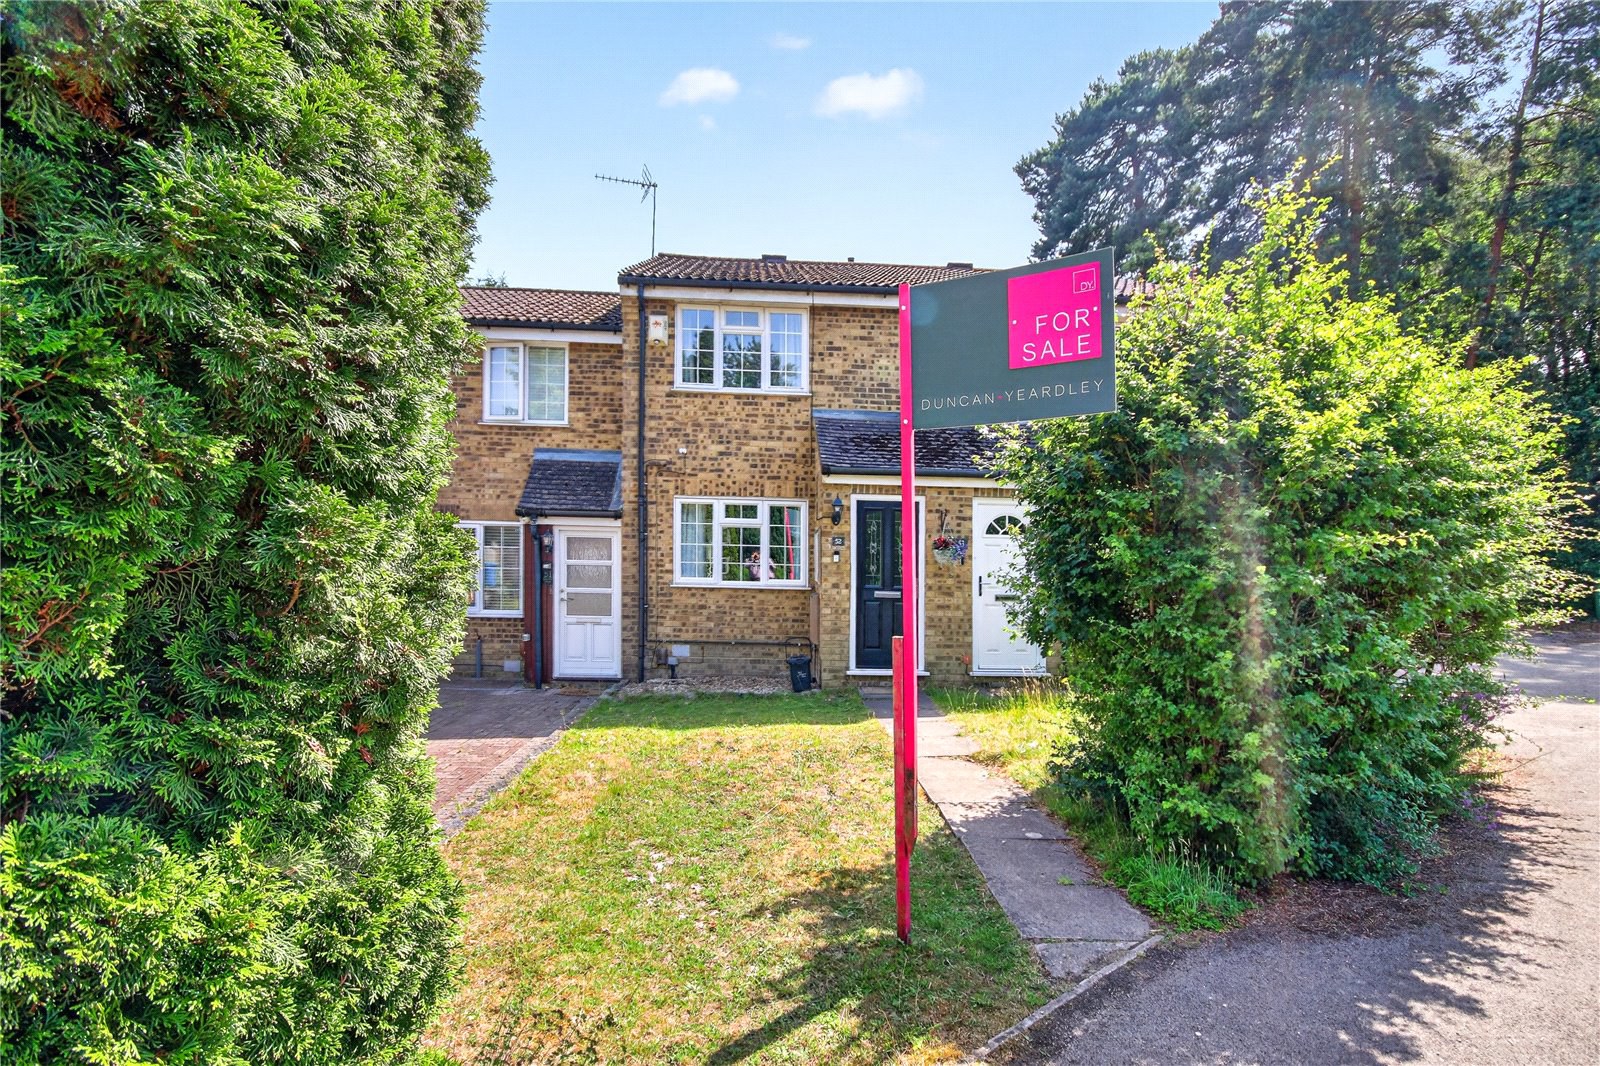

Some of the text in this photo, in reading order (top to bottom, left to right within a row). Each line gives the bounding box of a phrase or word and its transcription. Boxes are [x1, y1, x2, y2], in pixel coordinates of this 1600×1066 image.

[1035, 308, 1090, 335] FOR
[1022, 334, 1091, 362] SALE
[921, 379, 1104, 411] DUNCAN YEARDLEY
